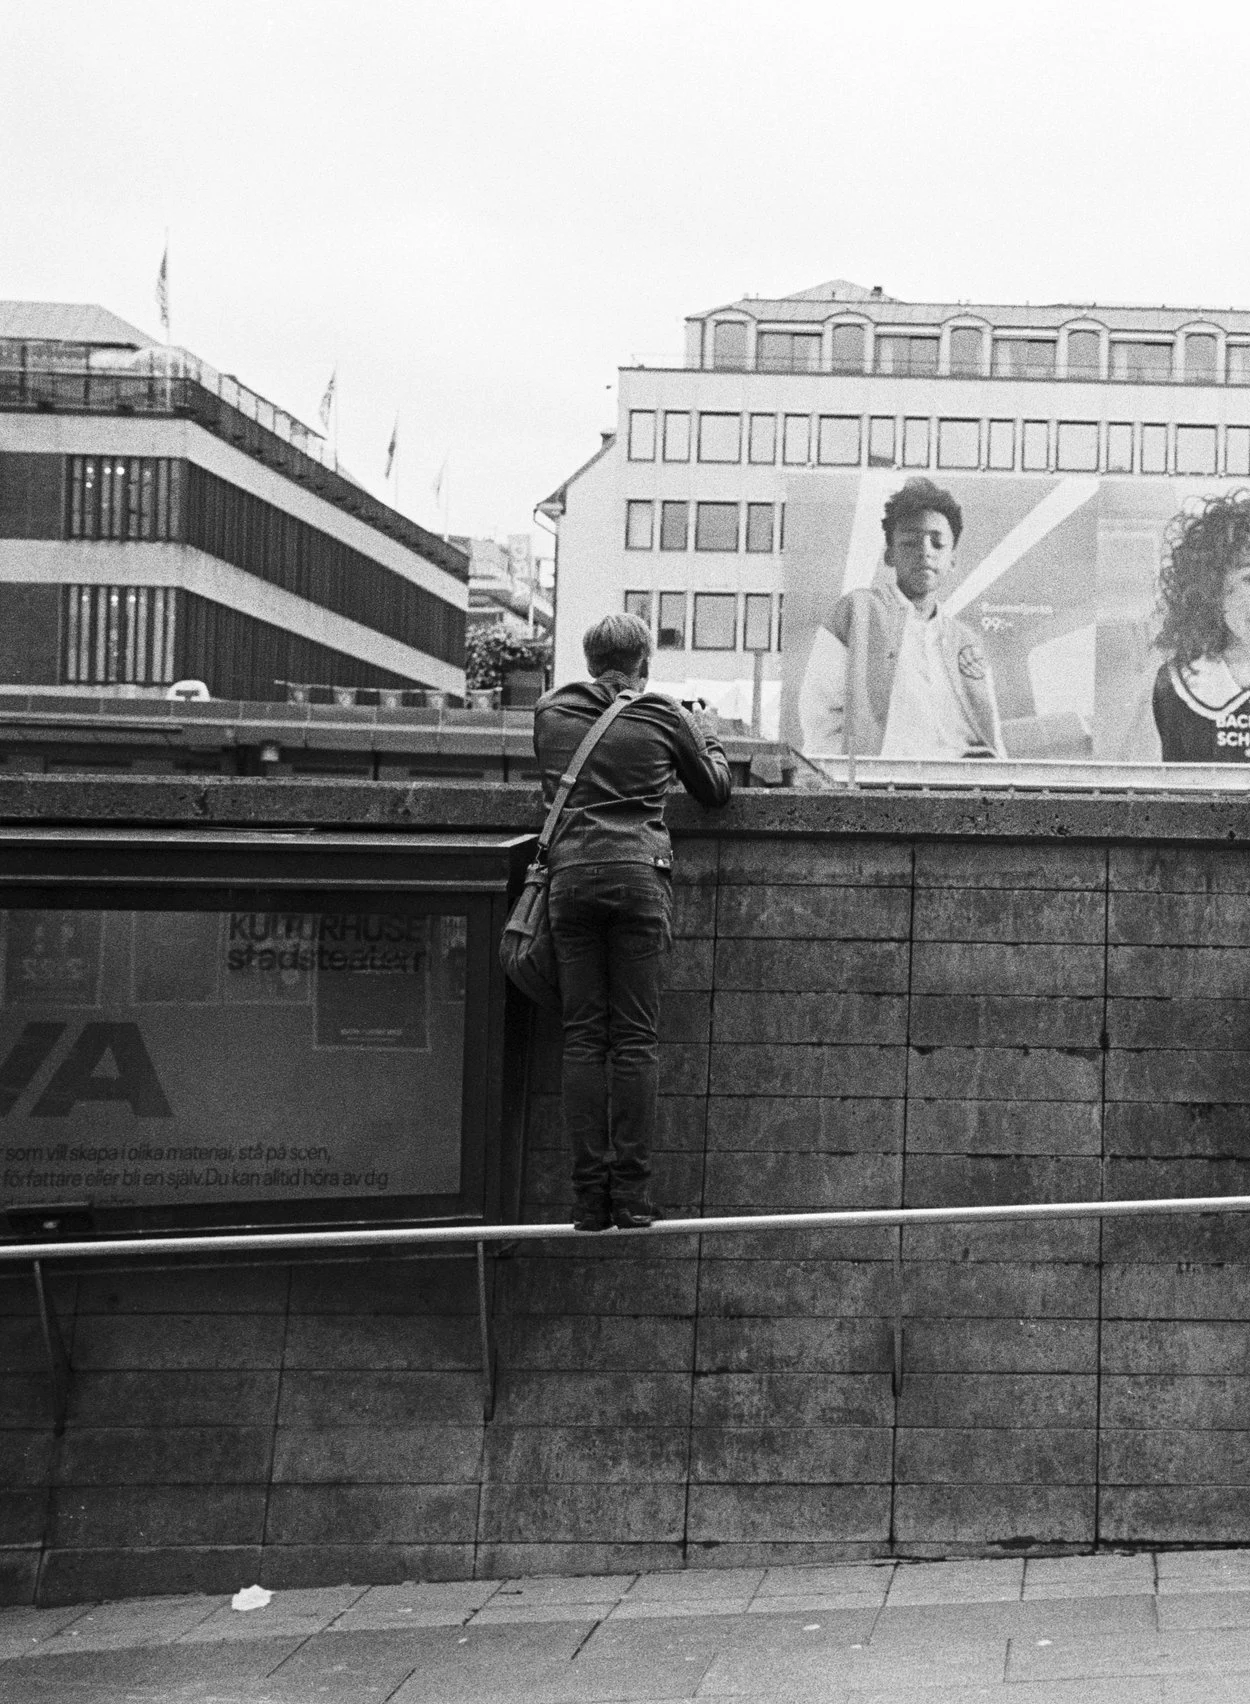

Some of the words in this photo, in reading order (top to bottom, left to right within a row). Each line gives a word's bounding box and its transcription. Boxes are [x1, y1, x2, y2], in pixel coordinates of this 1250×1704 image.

[5, 1147, 43, 1162] som
[47, 1143, 68, 1162] vill
[70, 1145, 118, 1165] skapa
[239, 1142, 263, 1161] stå
[266, 1142, 287, 1166] på
[3, 1167, 82, 1188] författare
[122, 1168, 140, 1187] bli
[143, 1173, 165, 1187] en
[231, 1168, 259, 1187] kan
[302, 1168, 340, 1187] höra
[342, 1173, 362, 1187] av
